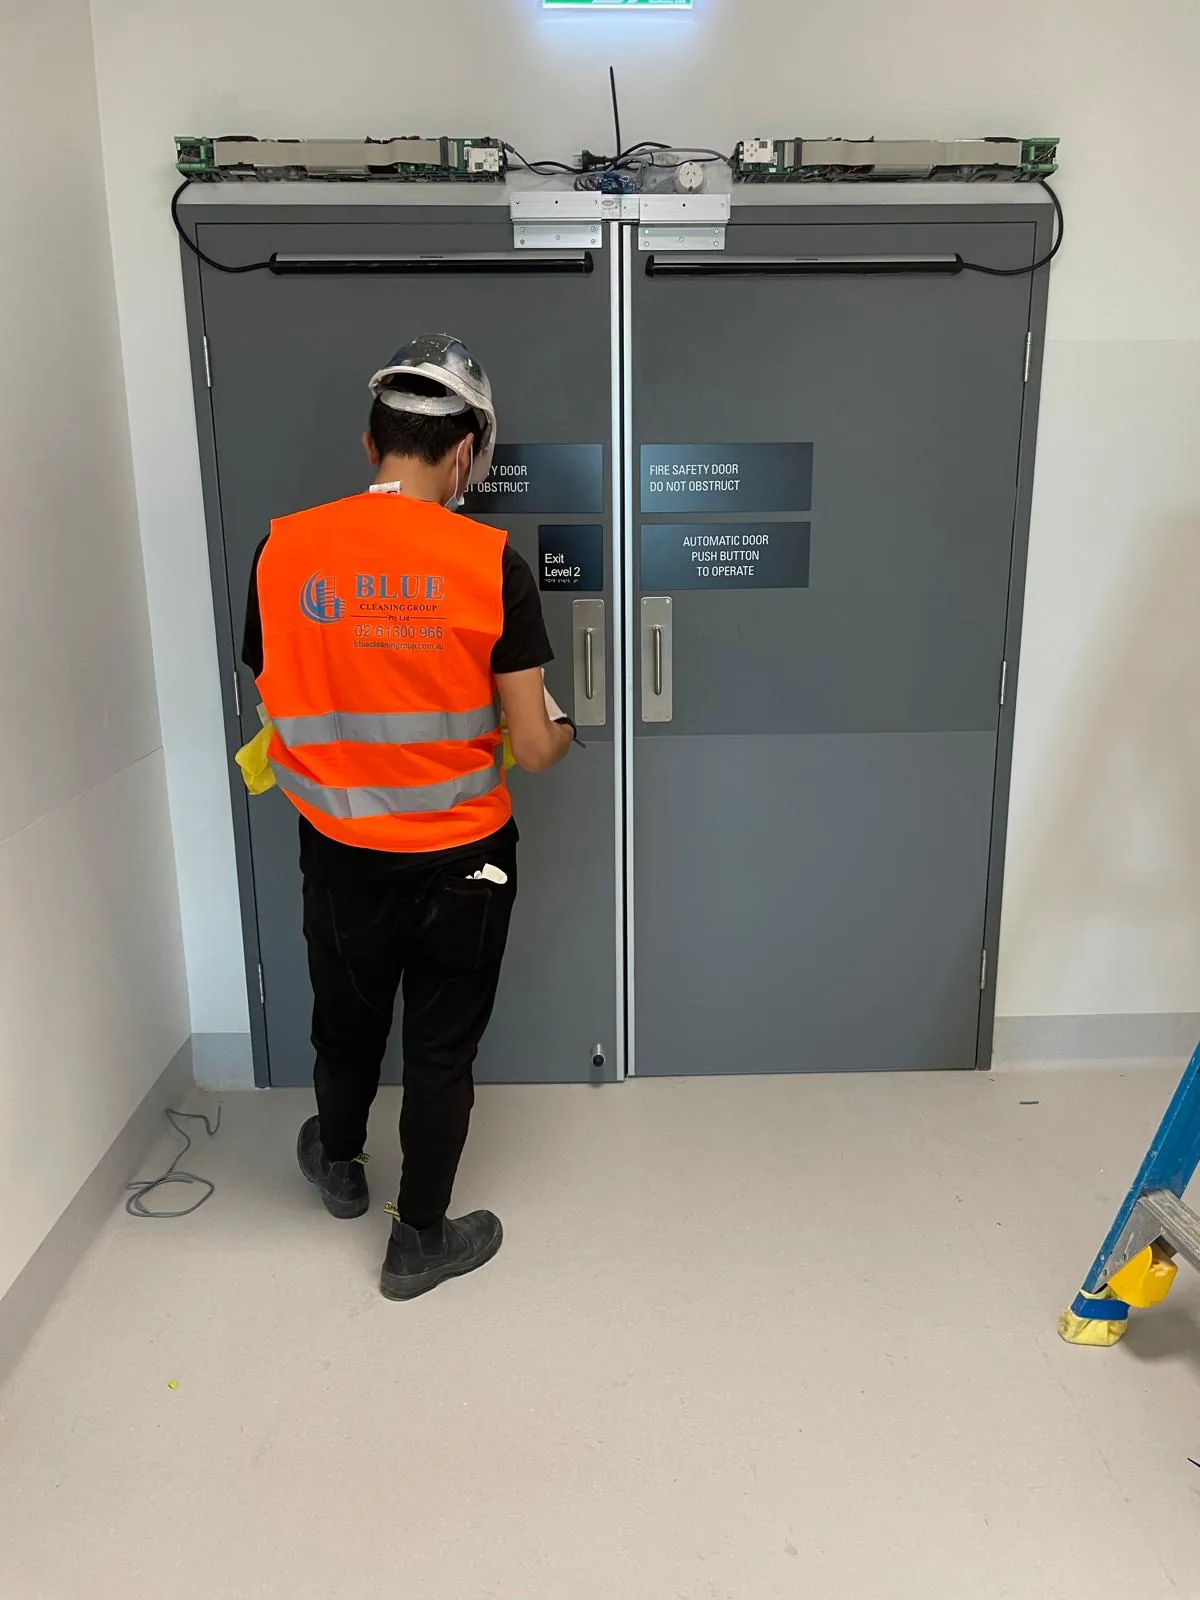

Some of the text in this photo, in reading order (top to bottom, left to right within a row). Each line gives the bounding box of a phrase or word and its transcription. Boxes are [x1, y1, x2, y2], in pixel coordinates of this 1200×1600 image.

[500, 465, 527, 476] DOOR
[649, 464, 739, 476] FIRE SAFETY DOOR
[478, 481, 530, 493] OBSTRUCT
[650, 480, 741, 492] DO NOT OBSTRUCT
[683, 535, 769, 547] AUTOMATIC DOOR
[544, 553, 565, 564] Exit
[691, 551, 760, 562] PUSH BUTTON
[544, 567, 581, 577] Level 2
[697, 566, 754, 577] TO OPERATE
[354, 573, 445, 600] BLUE
[359, 603, 437, 612] CLEANING GROUP
[354, 624, 443, 639] 02 61300 966
